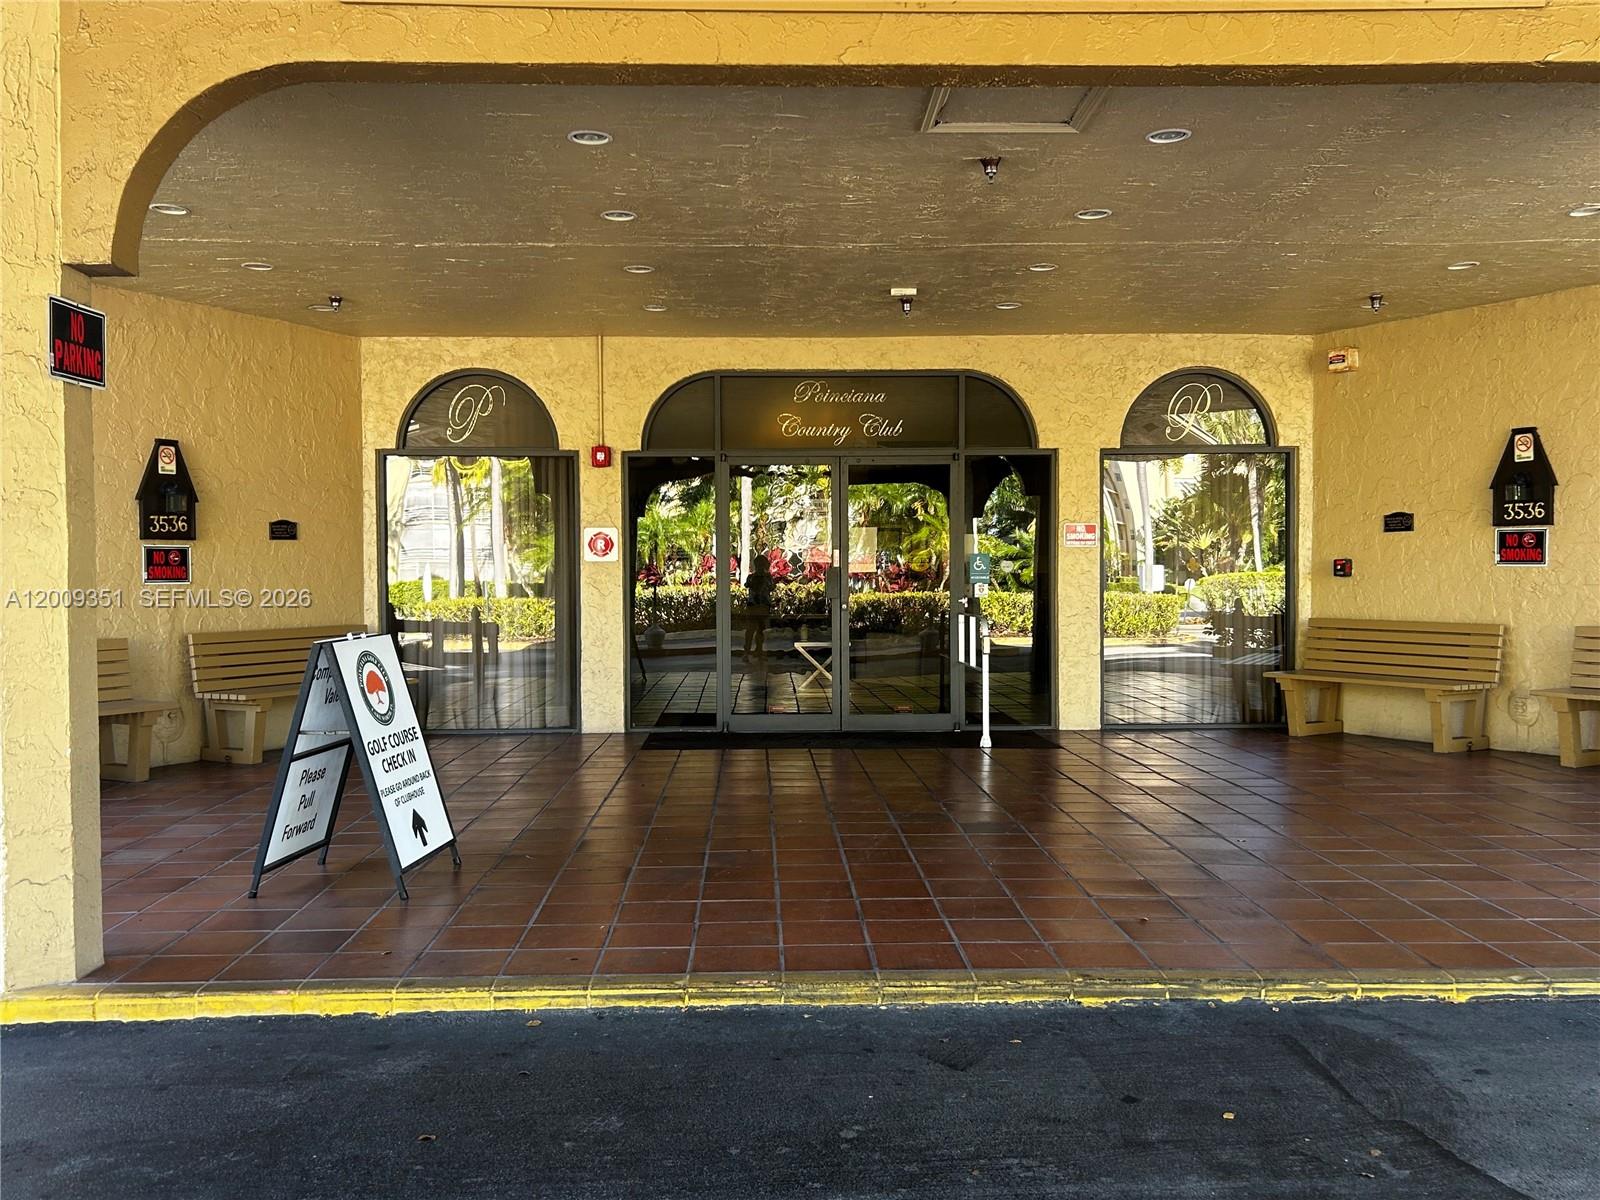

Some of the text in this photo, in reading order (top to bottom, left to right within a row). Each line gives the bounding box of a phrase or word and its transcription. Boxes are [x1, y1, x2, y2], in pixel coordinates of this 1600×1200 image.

[70, 311, 84, 343] NO
[54, 338, 101, 379] PARKING
[794, 380, 887, 403] Poinciana
[777, 413, 903, 446] Country Club
[1503, 502, 1545, 520] 3536
[149, 515, 188, 532] 3536
[1505, 534, 1518, 546] NO
[153, 551, 165, 565] NO
[1500, 548, 1542, 561] SMOKING
[148, 566, 186, 579] SMOKING
[367, 726, 419, 756] GOLF COURSE
[382, 748, 417, 774] CHECK IN
[299, 767, 326, 787] Please
[380, 770, 431, 798] PLEASE GO AROUND BACK
[298, 789, 316, 811] Pull
[400, 786, 425, 804] CLUBHOUSE
[282, 812, 317, 841] Forward
